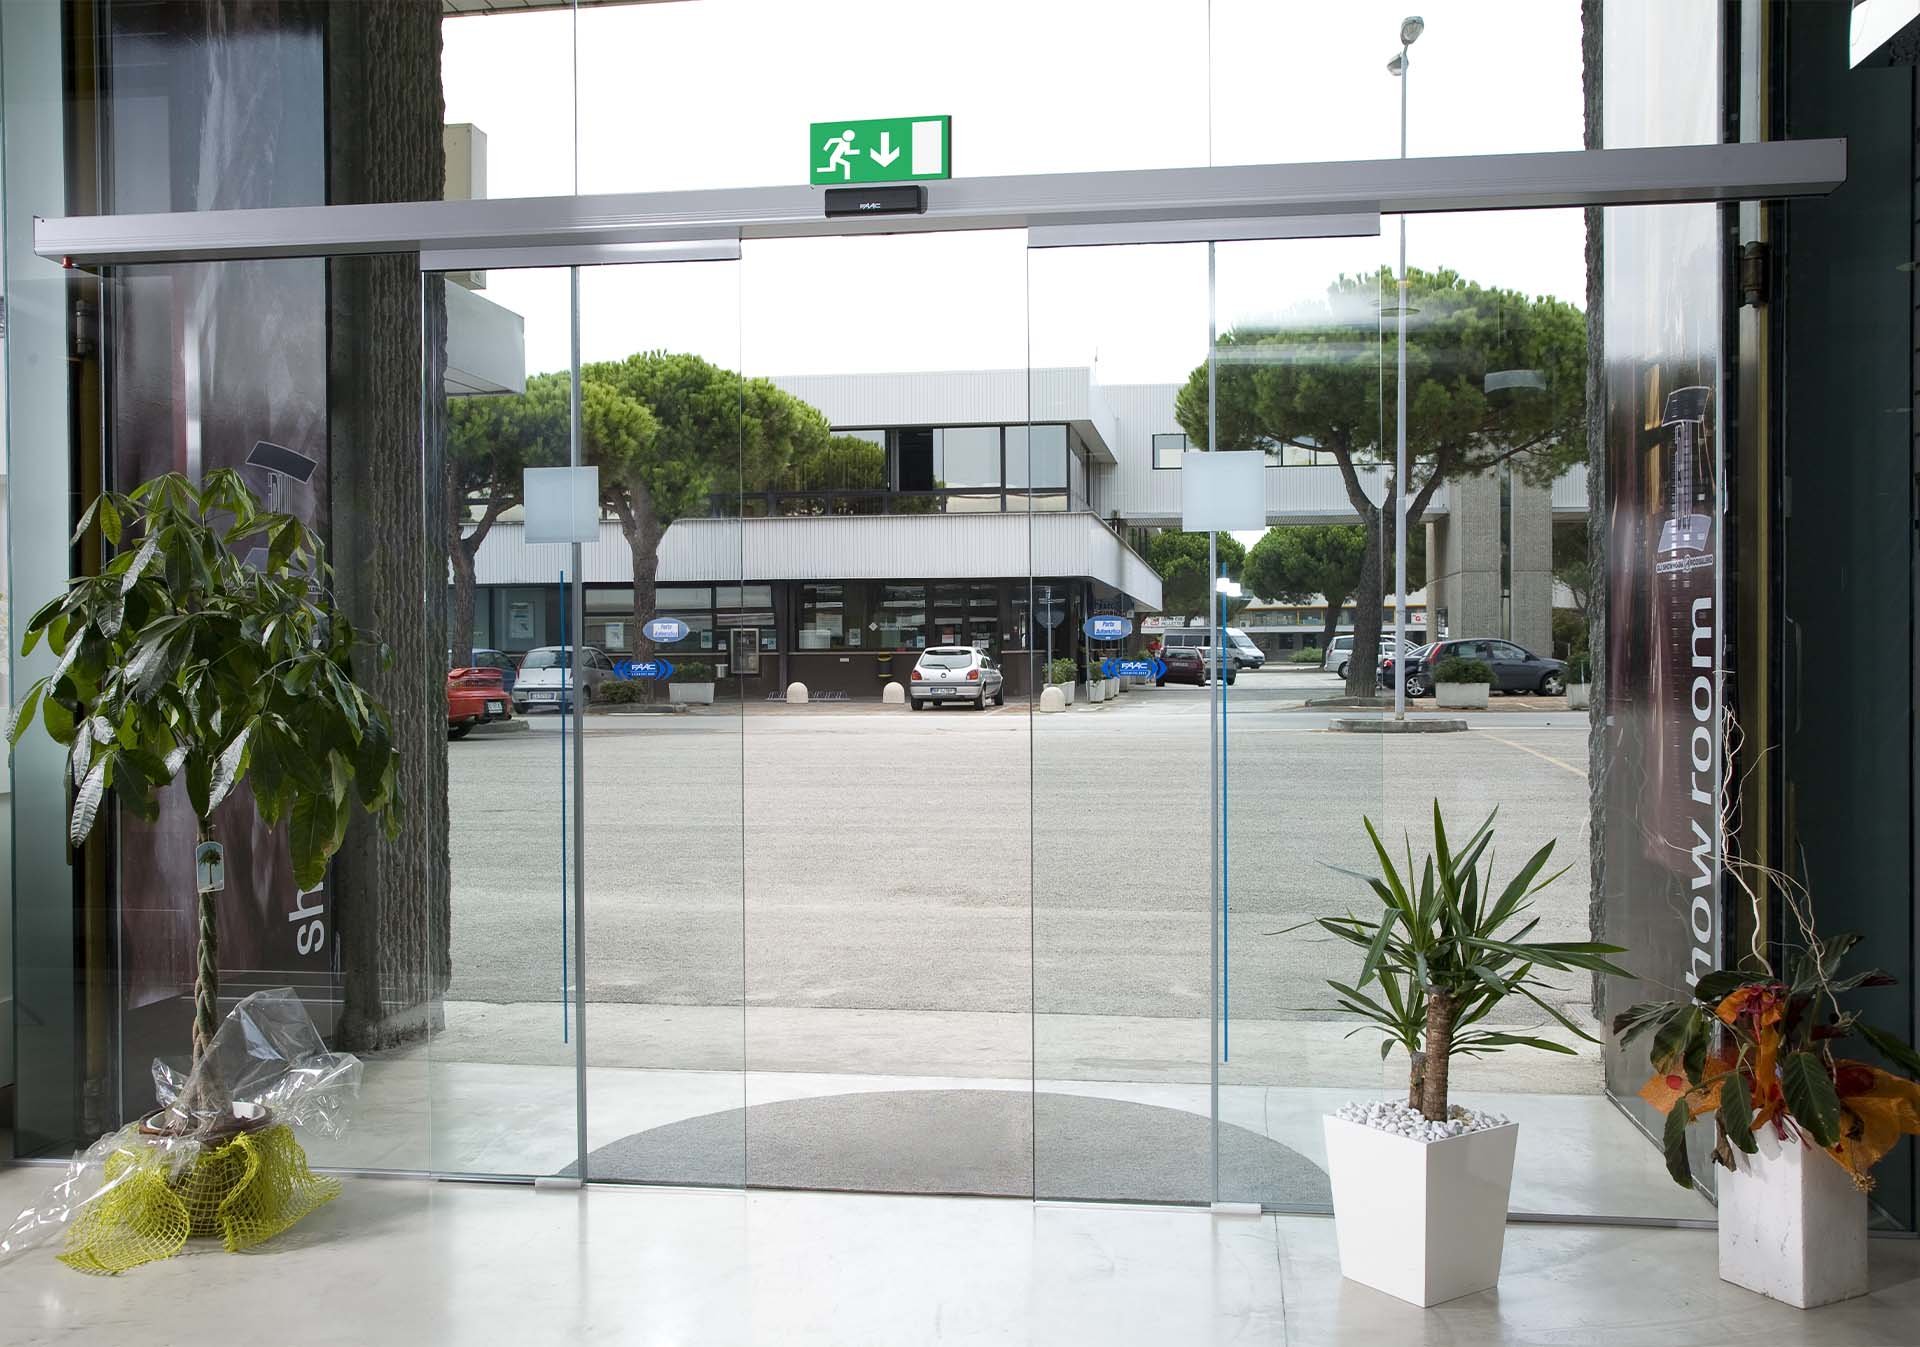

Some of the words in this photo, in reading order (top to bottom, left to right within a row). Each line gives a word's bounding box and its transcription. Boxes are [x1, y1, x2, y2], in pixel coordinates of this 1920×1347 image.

[1121, 662, 1148, 670] FAAC
[1691, 597, 1712, 805] room
[1685, 818, 1713, 1008] how
